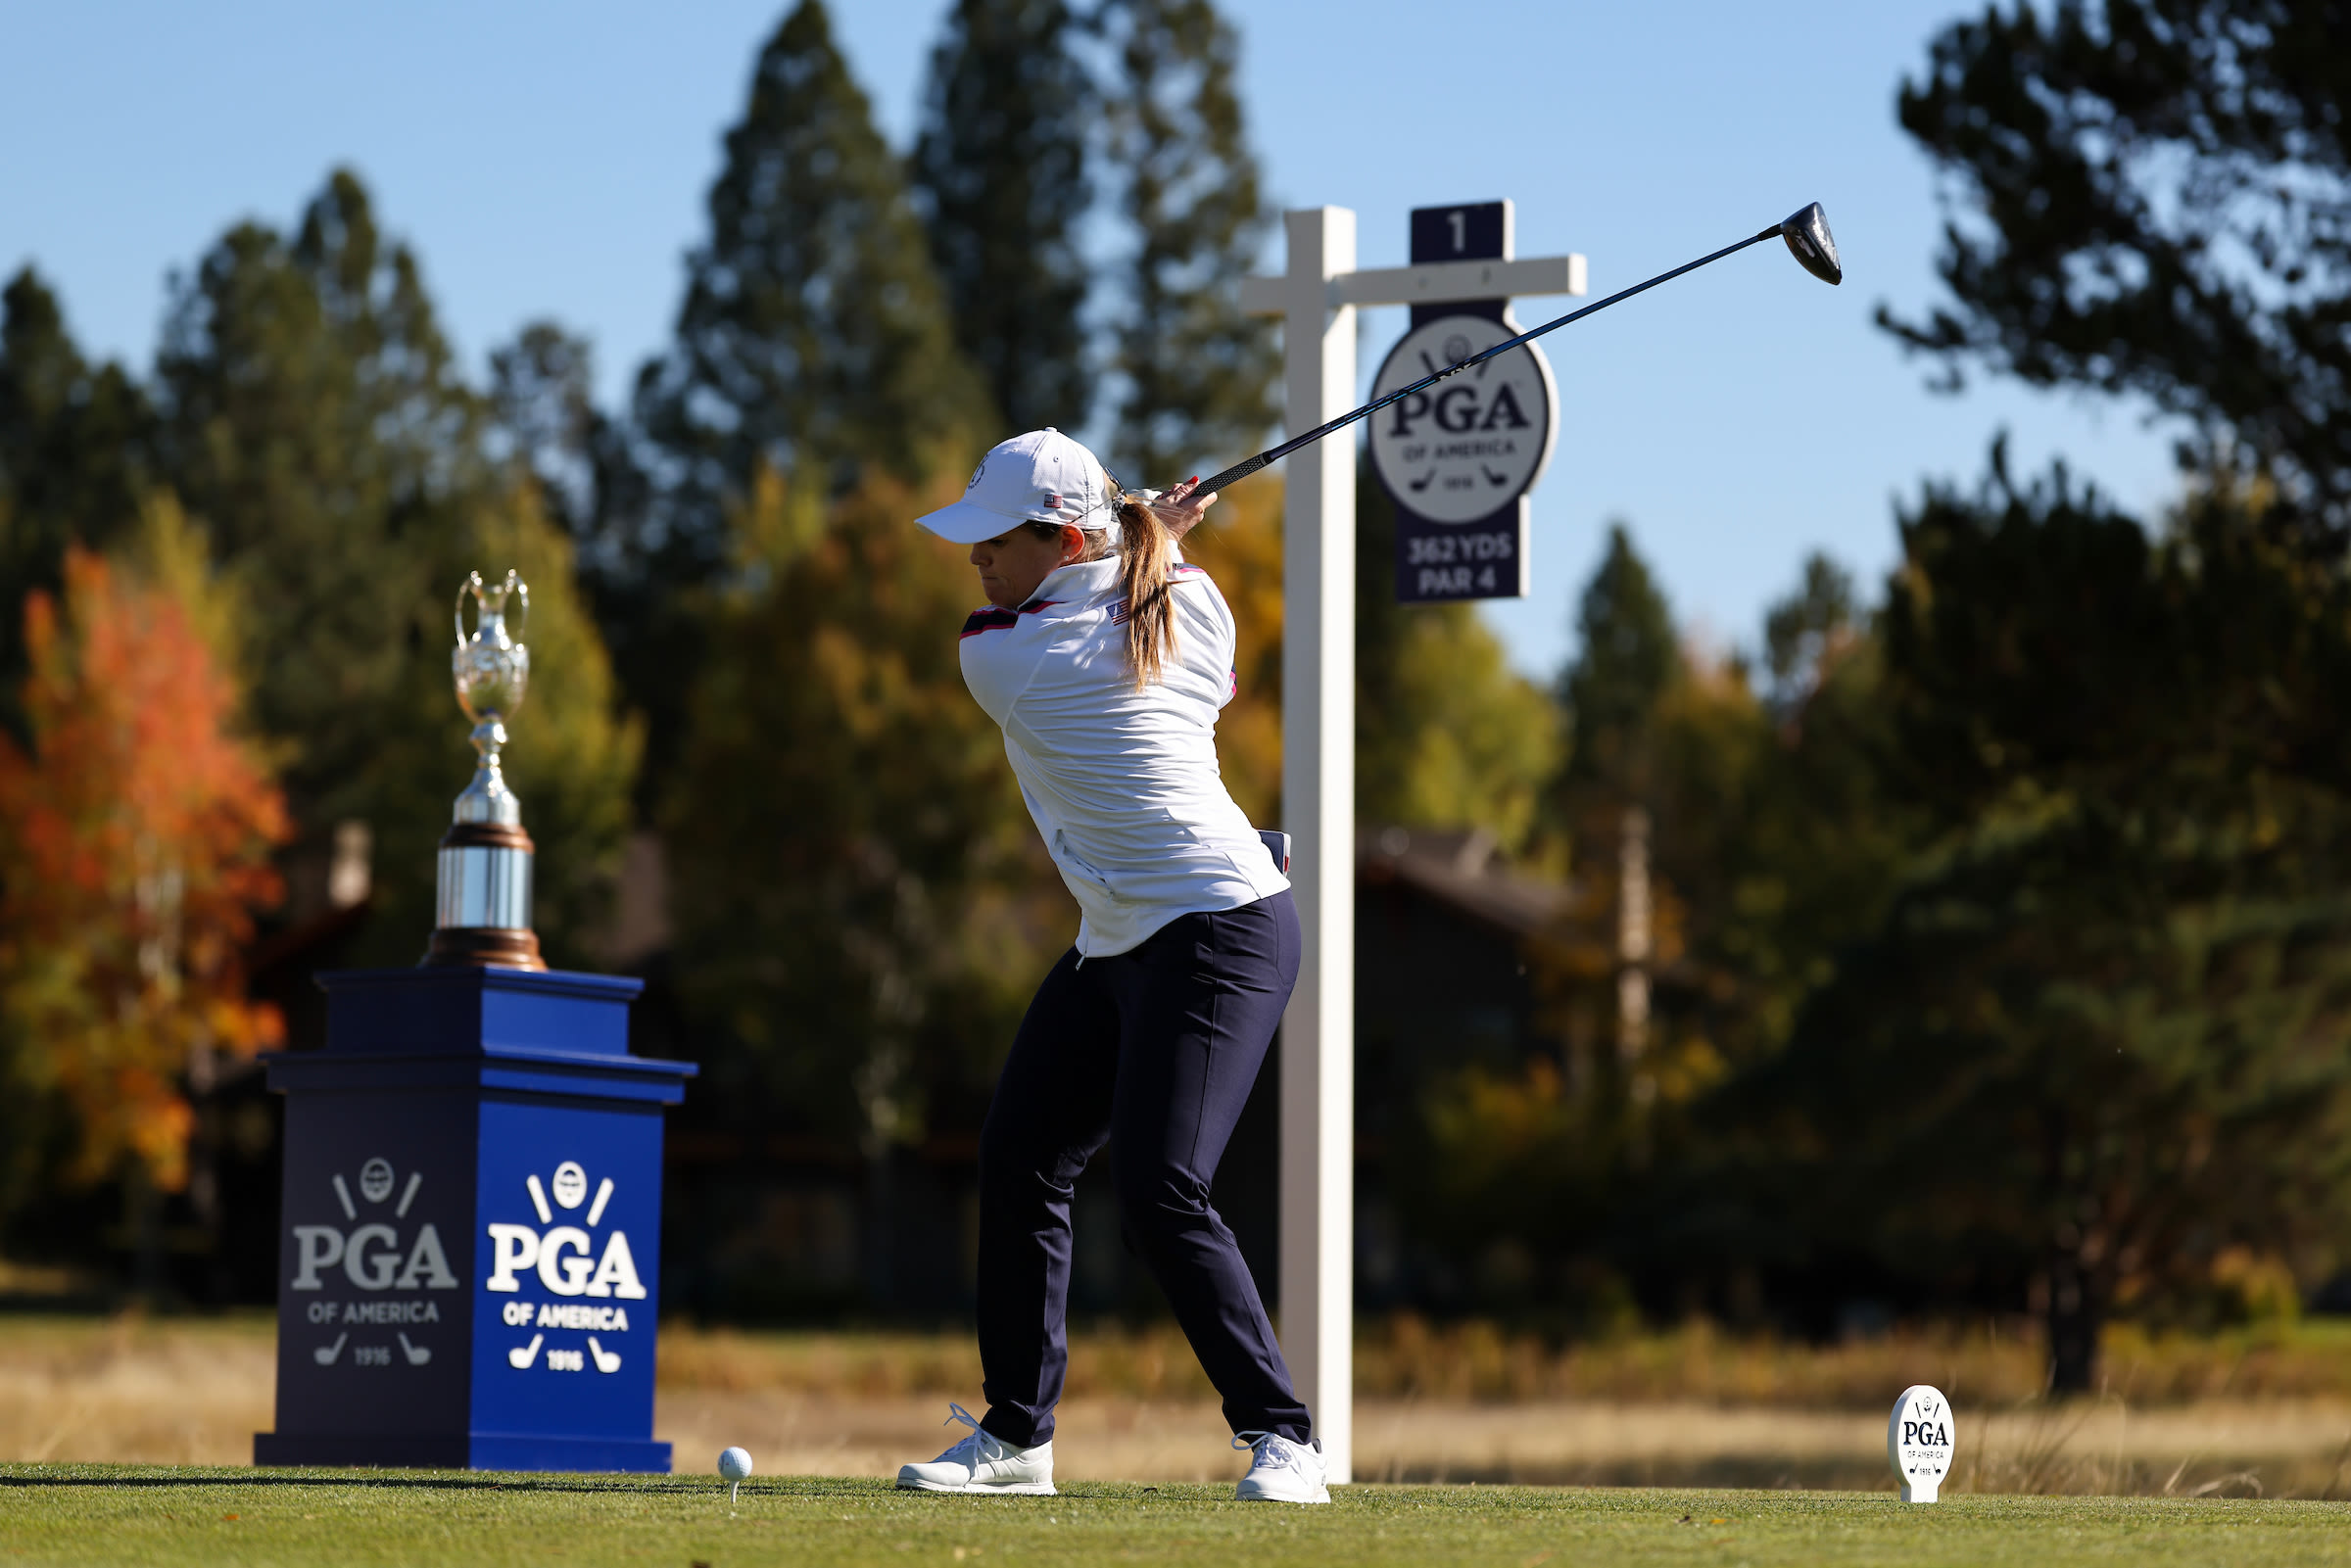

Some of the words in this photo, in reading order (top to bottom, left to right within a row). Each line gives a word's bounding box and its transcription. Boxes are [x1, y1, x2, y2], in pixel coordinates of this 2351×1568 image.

[1447, 211, 1465, 252] 1
[1389, 382, 1531, 437] PGA
[1402, 444, 1425, 462] OF
[1434, 440, 1515, 459] AMERICA
[1408, 535, 1456, 564] 362
[1459, 532, 1512, 560] YDS
[1418, 566, 1472, 595] PAR
[1478, 564, 1497, 592] 4
[292, 1223, 458, 1290] PGA
[487, 1223, 647, 1300] PGA
[308, 1302, 339, 1323] OF
[345, 1302, 440, 1323] AMERICA
[503, 1301, 535, 1326] OF
[537, 1305, 629, 1332] AMERICA
[355, 1347, 392, 1366] 1916
[547, 1350, 584, 1372] 1916
[1903, 1421, 1949, 1446] PGA
[1917, 1450, 1944, 1459] AMERICA
